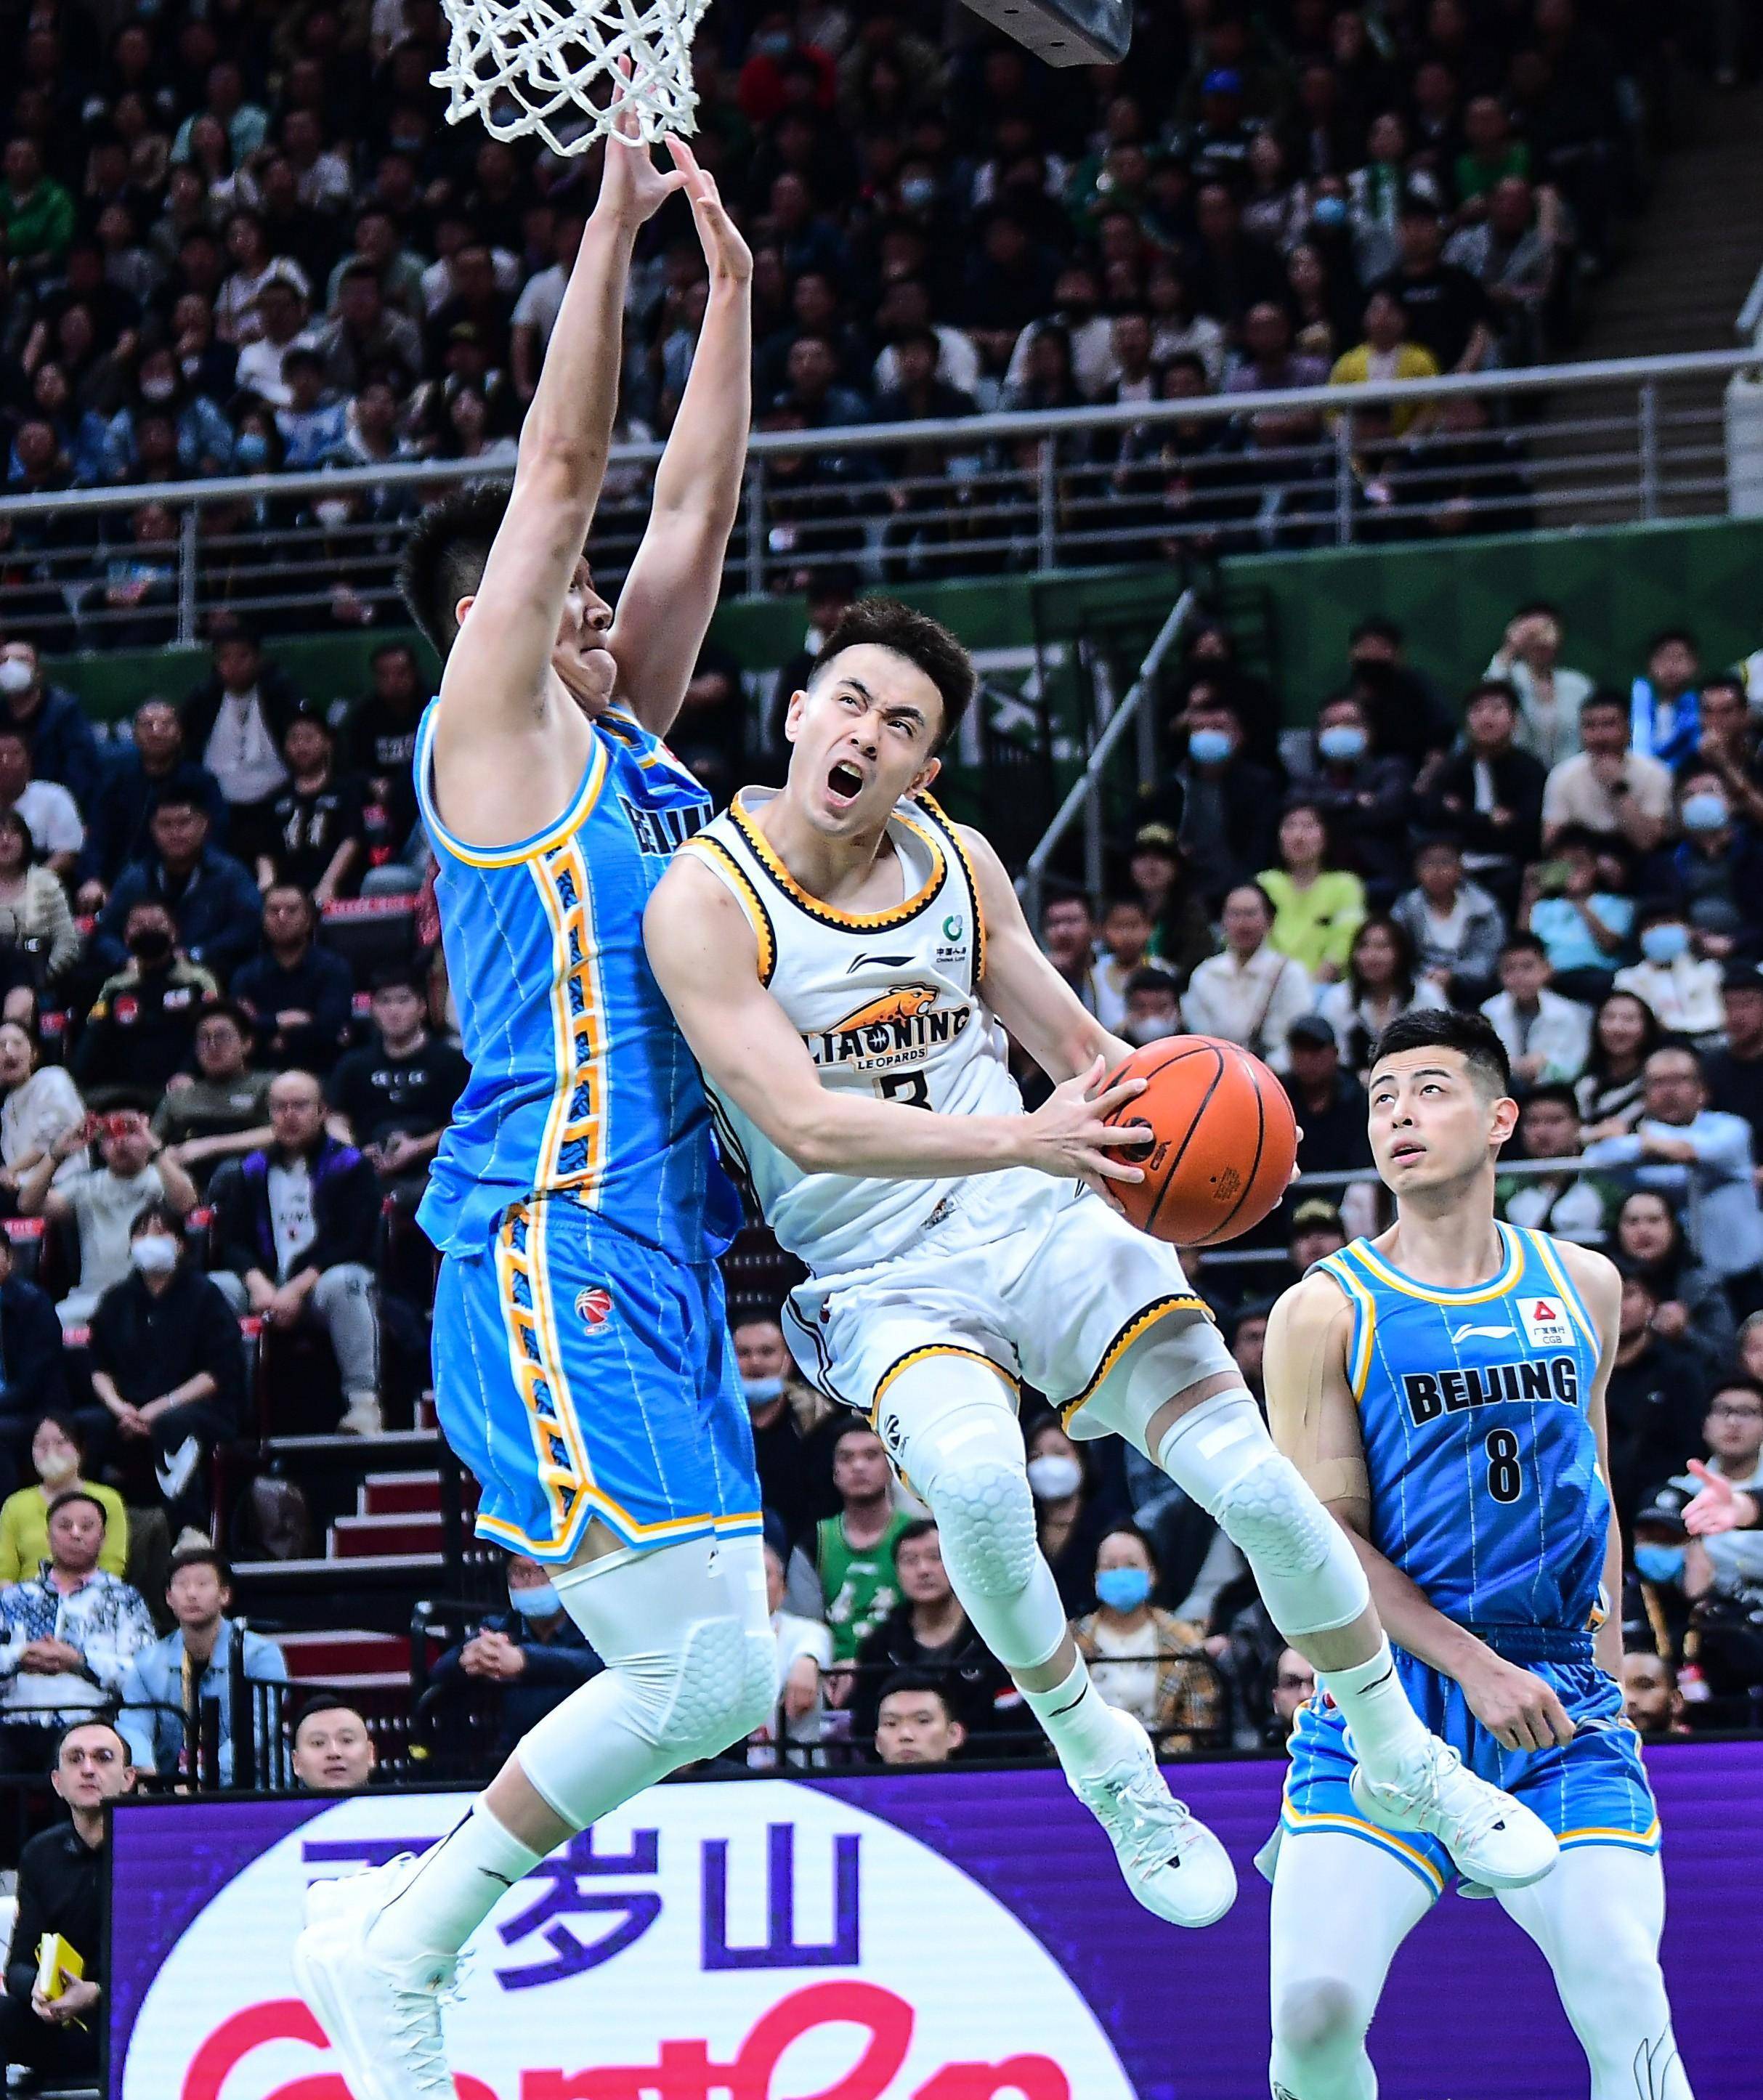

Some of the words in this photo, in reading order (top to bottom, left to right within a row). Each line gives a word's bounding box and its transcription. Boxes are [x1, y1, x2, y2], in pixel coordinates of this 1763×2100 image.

[617, 793, 713, 856] BEIJI
[857, 1048, 926, 1070] LEOPARDS
[1401, 1355, 1579, 1428] BEIJING
[1486, 1428, 1523, 1504] 8
